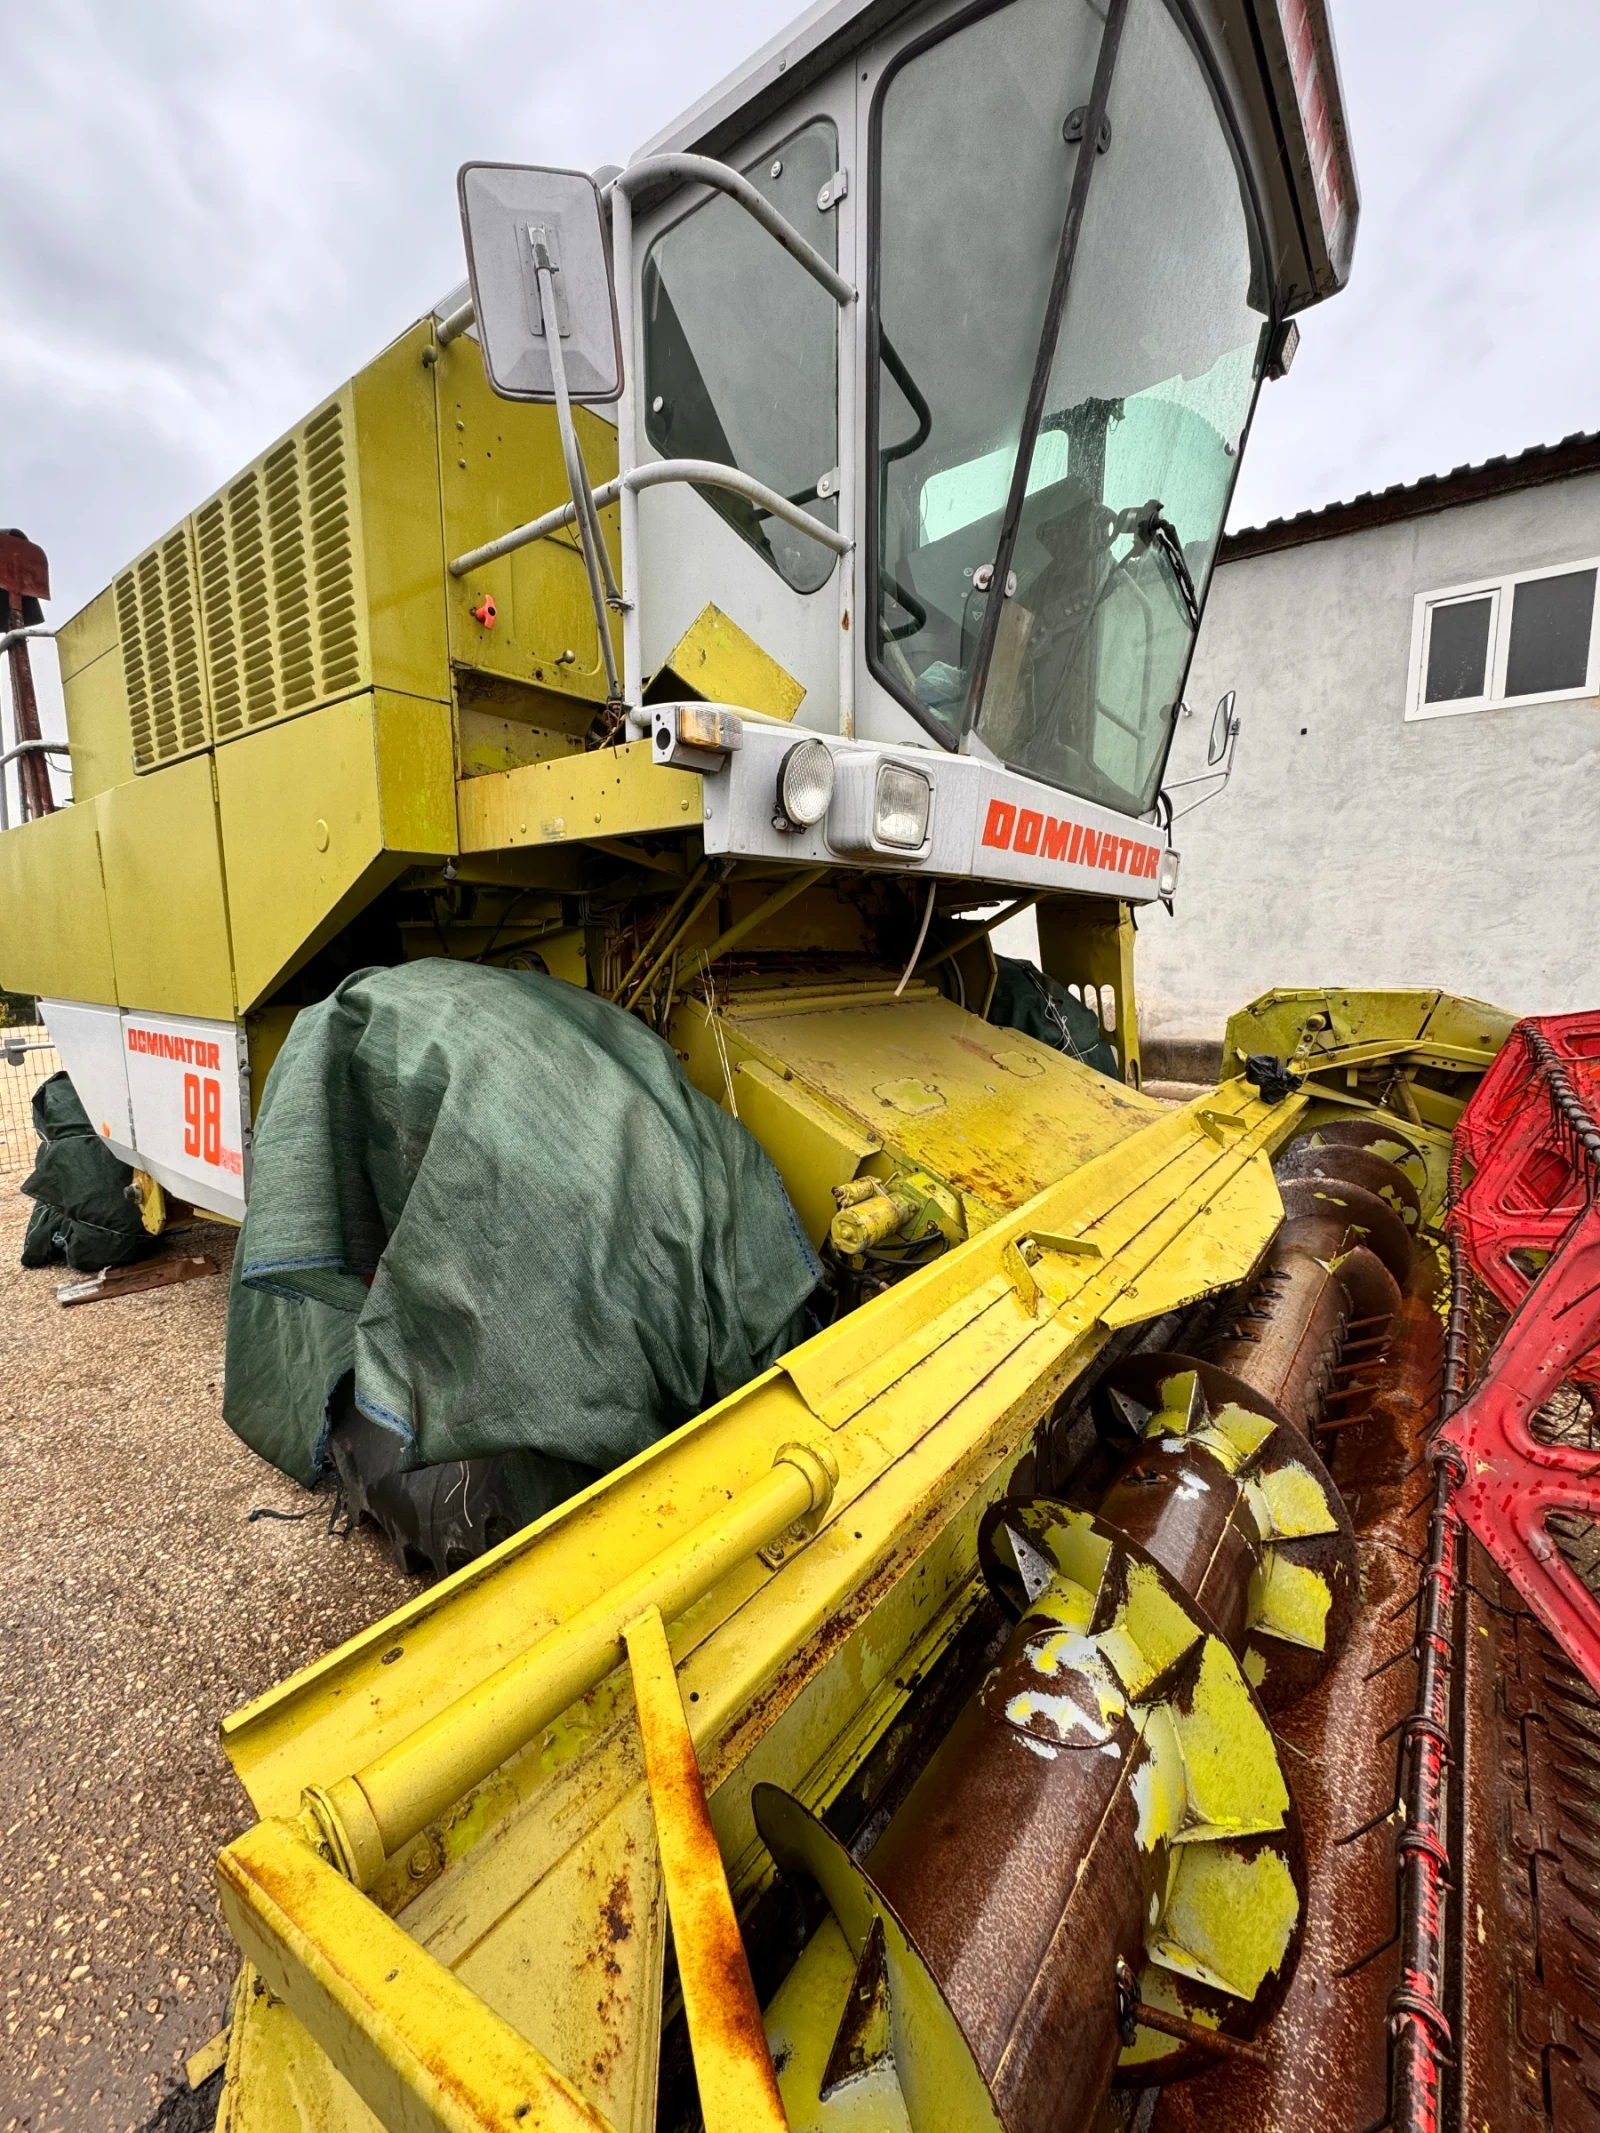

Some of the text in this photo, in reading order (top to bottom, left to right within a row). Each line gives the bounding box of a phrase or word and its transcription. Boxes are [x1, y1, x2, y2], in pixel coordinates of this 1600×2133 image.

[981, 798, 1161, 880] DOMINATOR
[127, 1027, 221, 1071] DOMINATOR
[184, 1072, 221, 1167] 98
